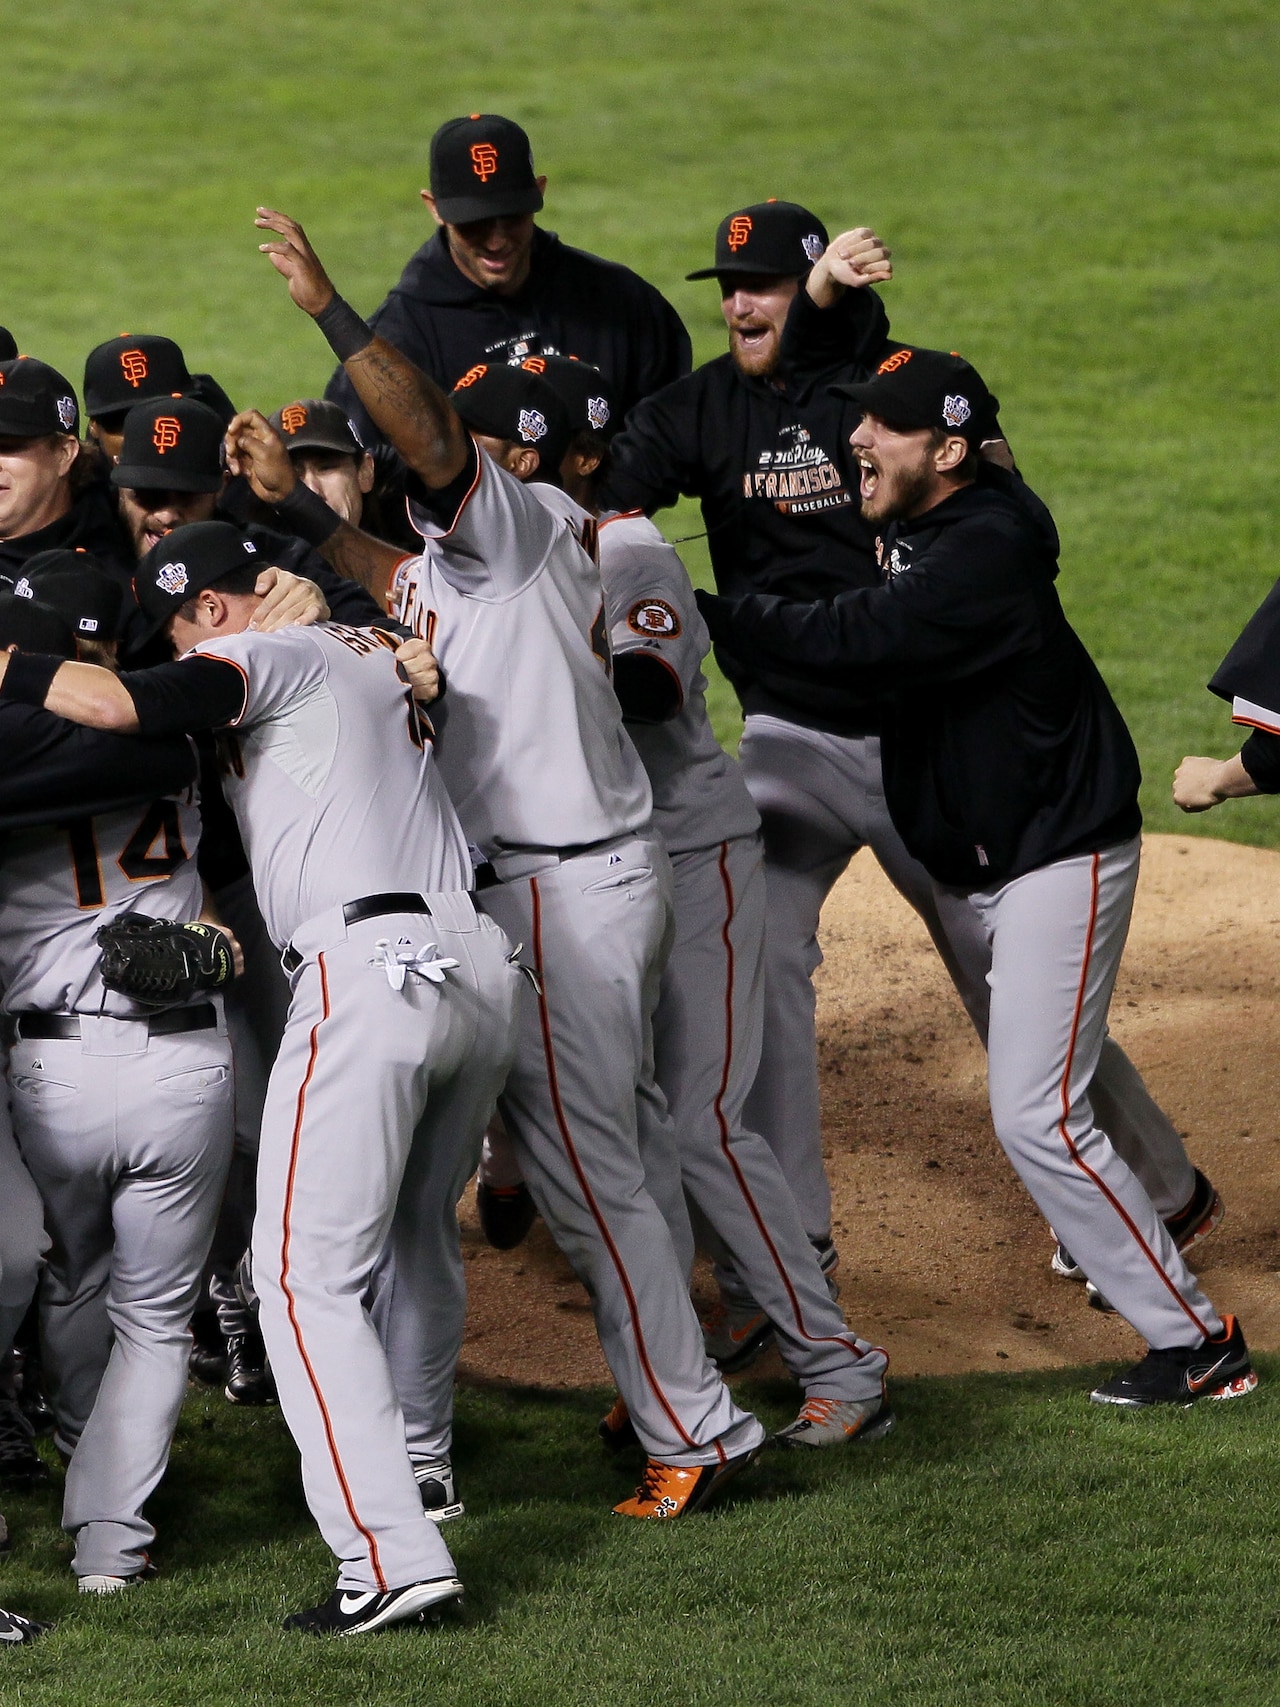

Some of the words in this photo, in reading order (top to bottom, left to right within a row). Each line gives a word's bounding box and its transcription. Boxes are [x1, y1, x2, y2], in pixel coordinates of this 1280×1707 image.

[470, 143, 498, 183] SF
[727, 215, 753, 252] SF
[119, 349, 147, 388] SF
[454, 364, 488, 391] SF
[877, 349, 912, 375] SF
[152, 416, 181, 455] SF
[281, 404, 307, 435] SF
[754, 463, 841, 498] FRANCISCO
[791, 495, 842, 514] BASEBALL
[70, 798, 192, 911] 14
